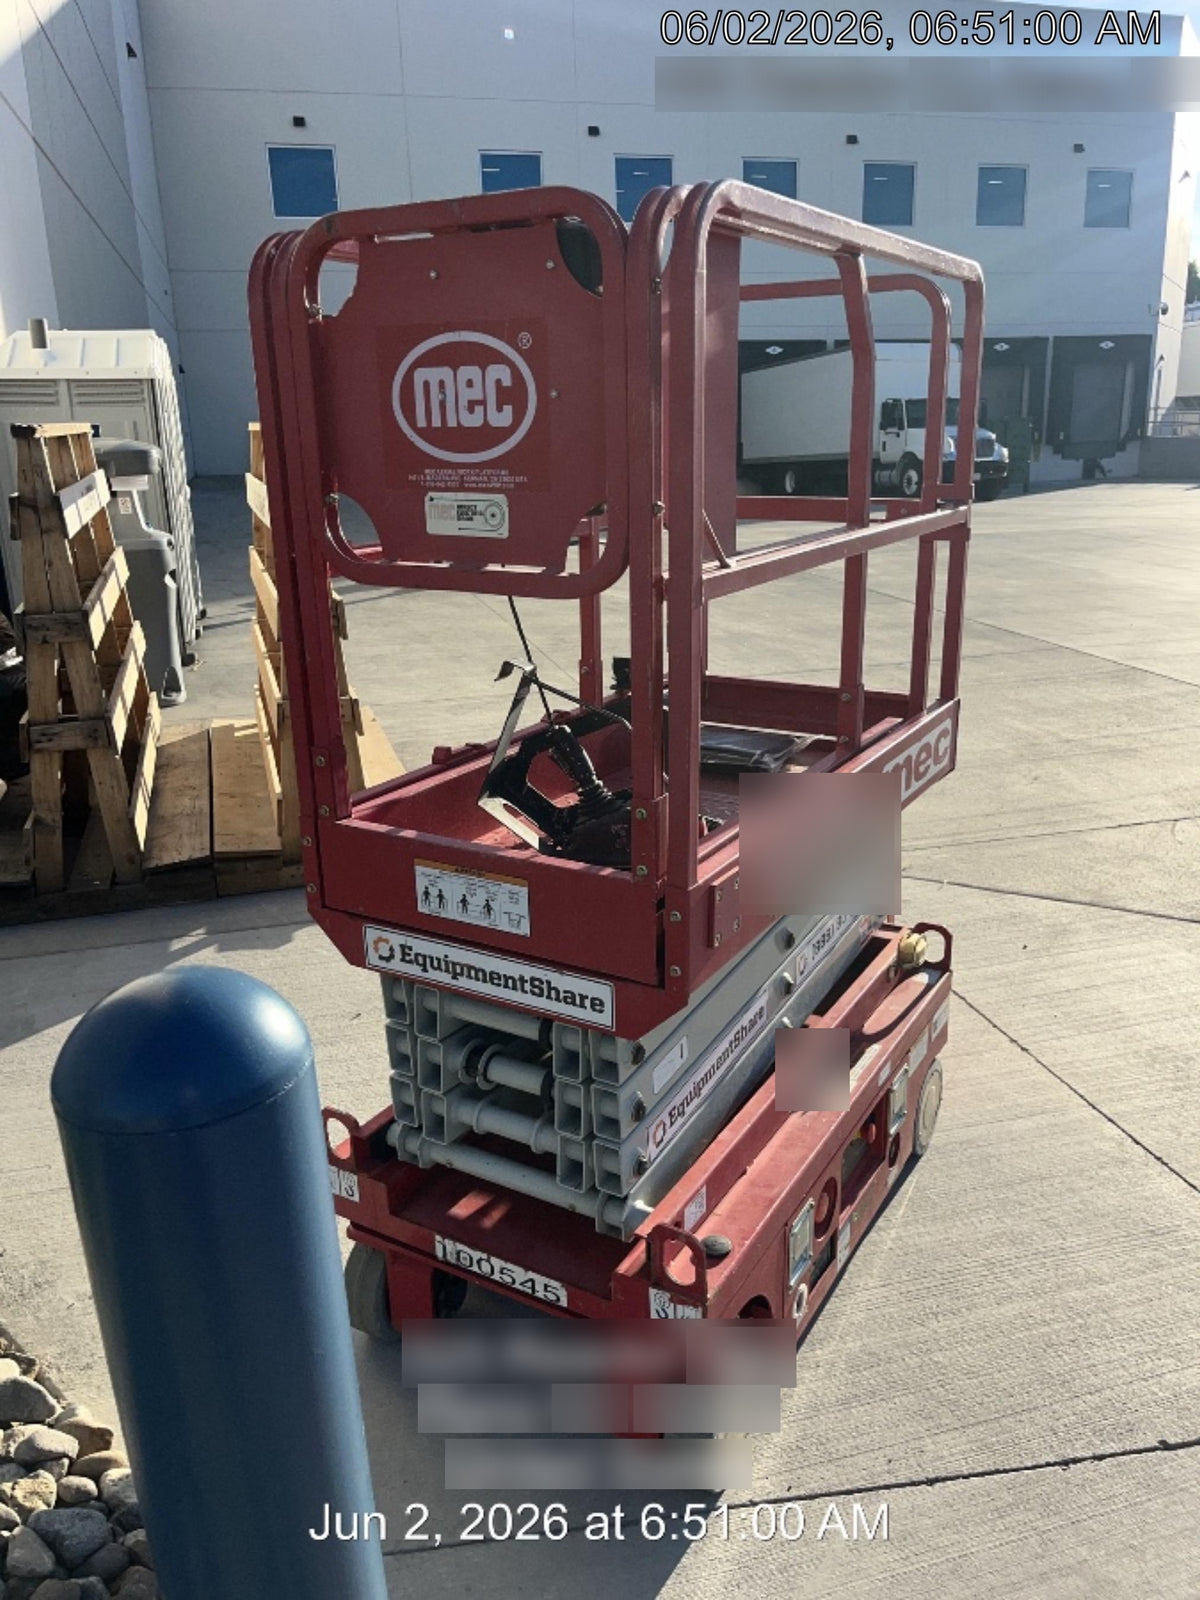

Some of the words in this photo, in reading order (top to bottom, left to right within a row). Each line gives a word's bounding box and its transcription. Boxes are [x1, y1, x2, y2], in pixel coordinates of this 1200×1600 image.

[414, 364, 513, 428] mec
[399, 942, 606, 1015] EquipmentShare
[667, 1005, 765, 1127] EquipmentShare
